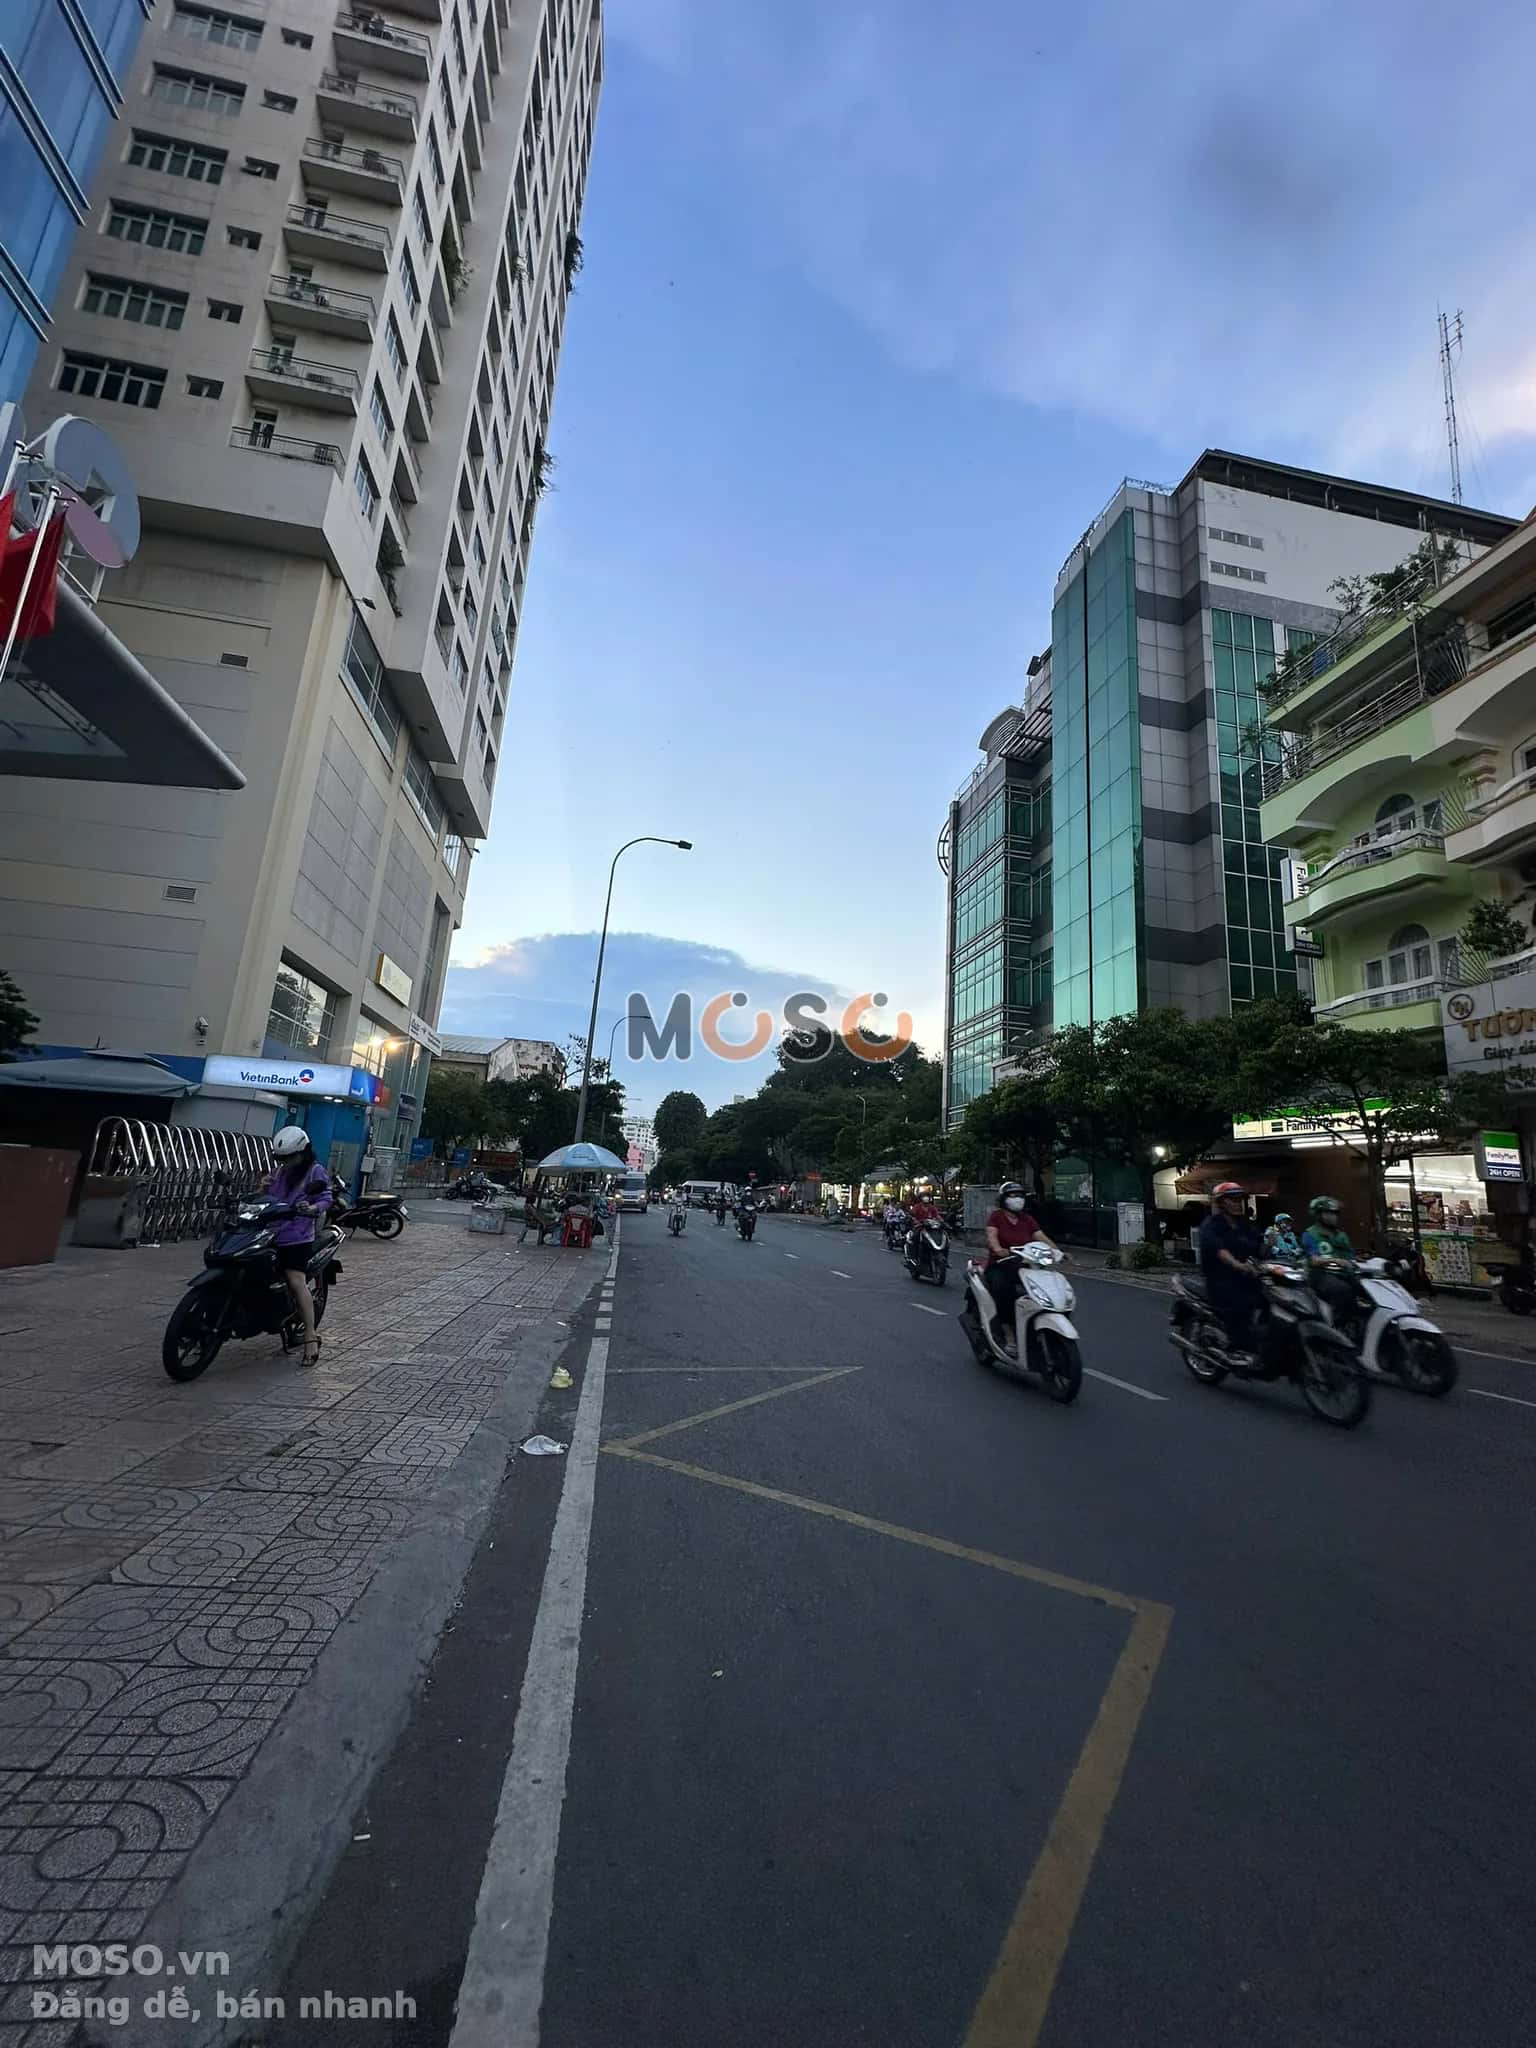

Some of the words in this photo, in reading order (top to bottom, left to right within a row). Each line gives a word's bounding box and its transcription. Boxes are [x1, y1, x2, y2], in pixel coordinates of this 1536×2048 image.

[240, 1071, 299, 1086] VietinBank
[1487, 1152, 1517, 1161] FamilyMart
[1488, 1168, 1502, 1177] 24H
[1503, 1169, 1521, 1178] OPEN
